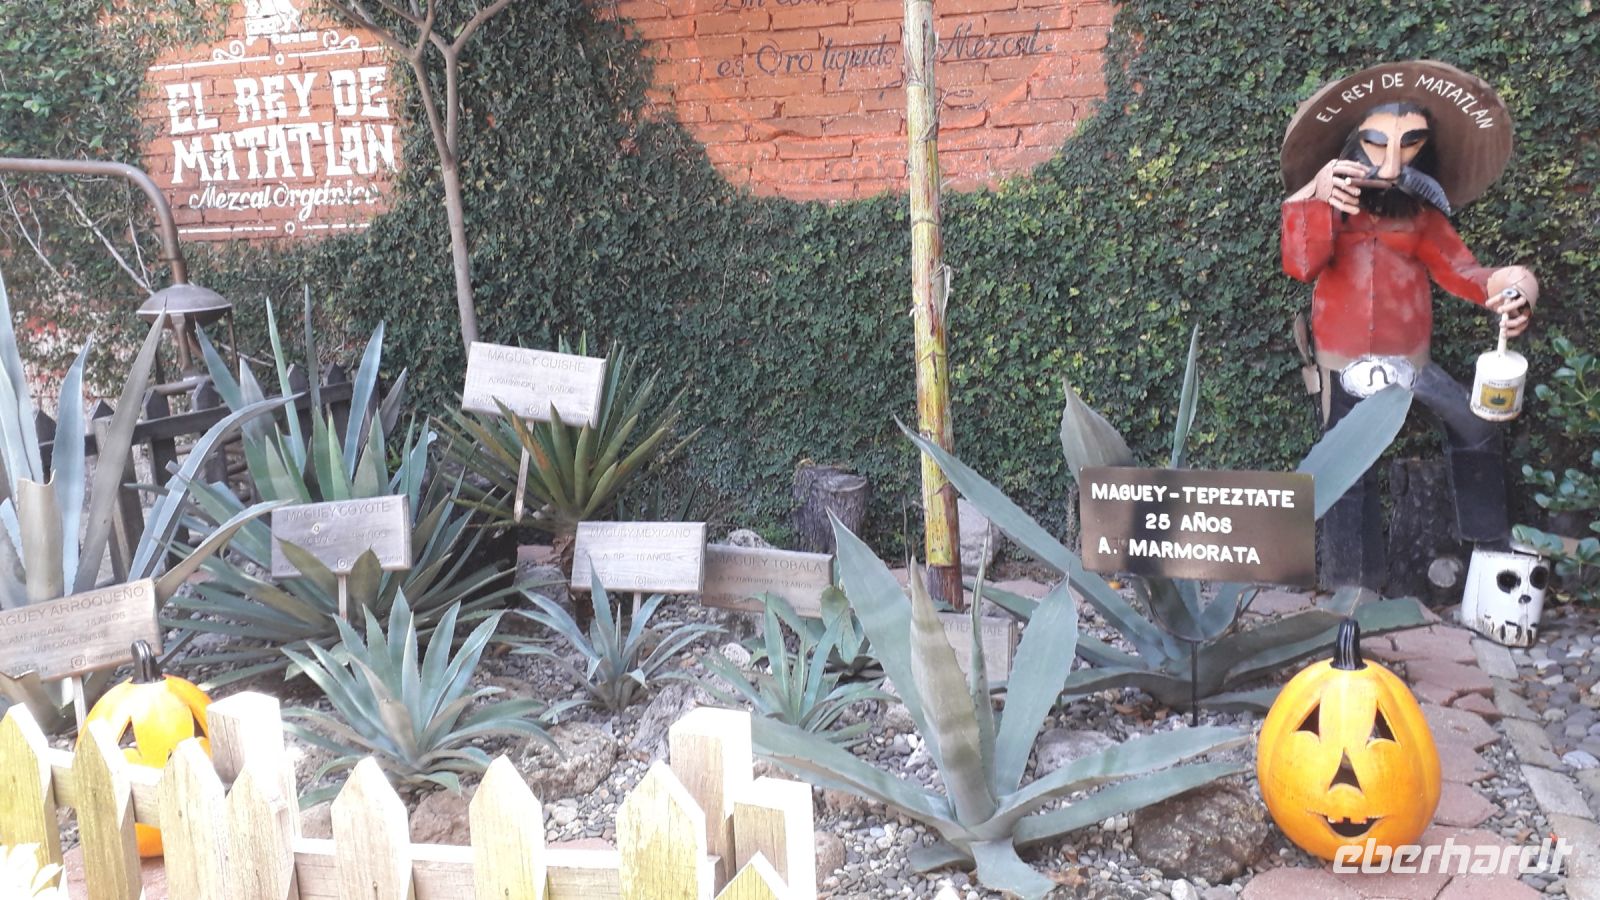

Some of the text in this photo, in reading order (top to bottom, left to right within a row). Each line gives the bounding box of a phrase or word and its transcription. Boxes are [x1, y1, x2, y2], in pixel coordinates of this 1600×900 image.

[756, 39, 813, 76] Oro
[165, 66, 390, 134] EL REY DE
[1316, 106, 1342, 123] EL
[1341, 80, 1374, 104] REY
[1382, 73, 1404, 89] DE
[189, 181, 271, 211] Mezcal
[287, 501, 391, 521] MAGUEY COYOTE
[1145, 512, 1232, 534] 25 AÑOS
[1098, 536, 1261, 565] A. MARMORATA
